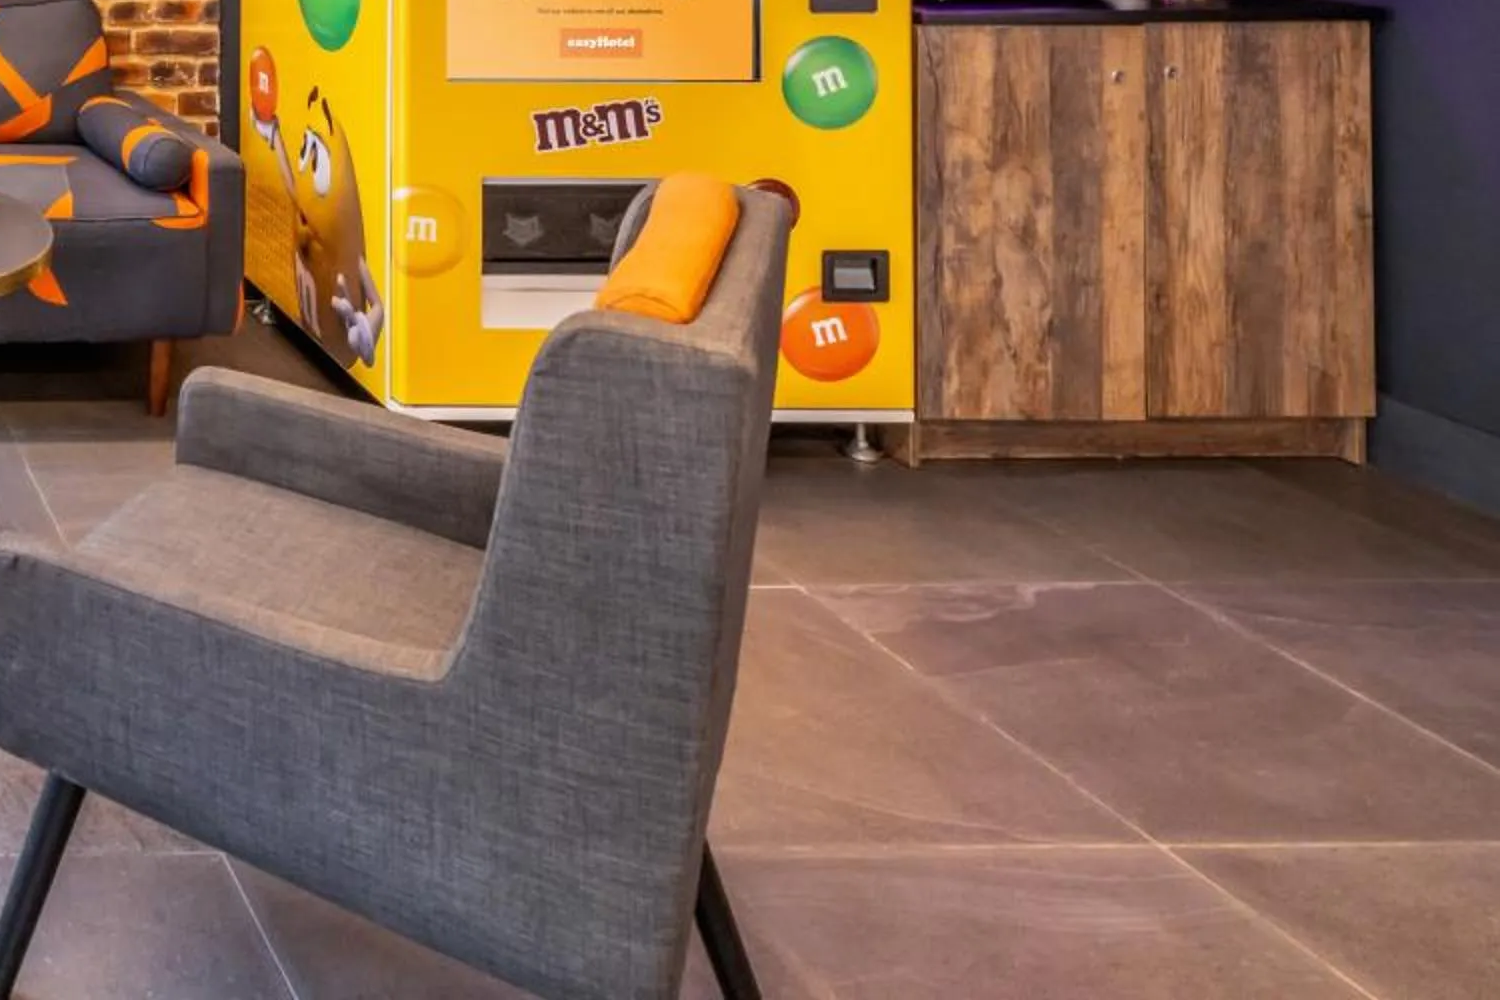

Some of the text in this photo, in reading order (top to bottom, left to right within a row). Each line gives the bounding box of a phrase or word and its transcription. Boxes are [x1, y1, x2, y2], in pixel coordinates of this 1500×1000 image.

[566, 34, 635, 50] easyHotel
[257, 70, 269, 94] m
[811, 65, 848, 98] m
[404, 215, 437, 243] m
[811, 314, 848, 349] m
